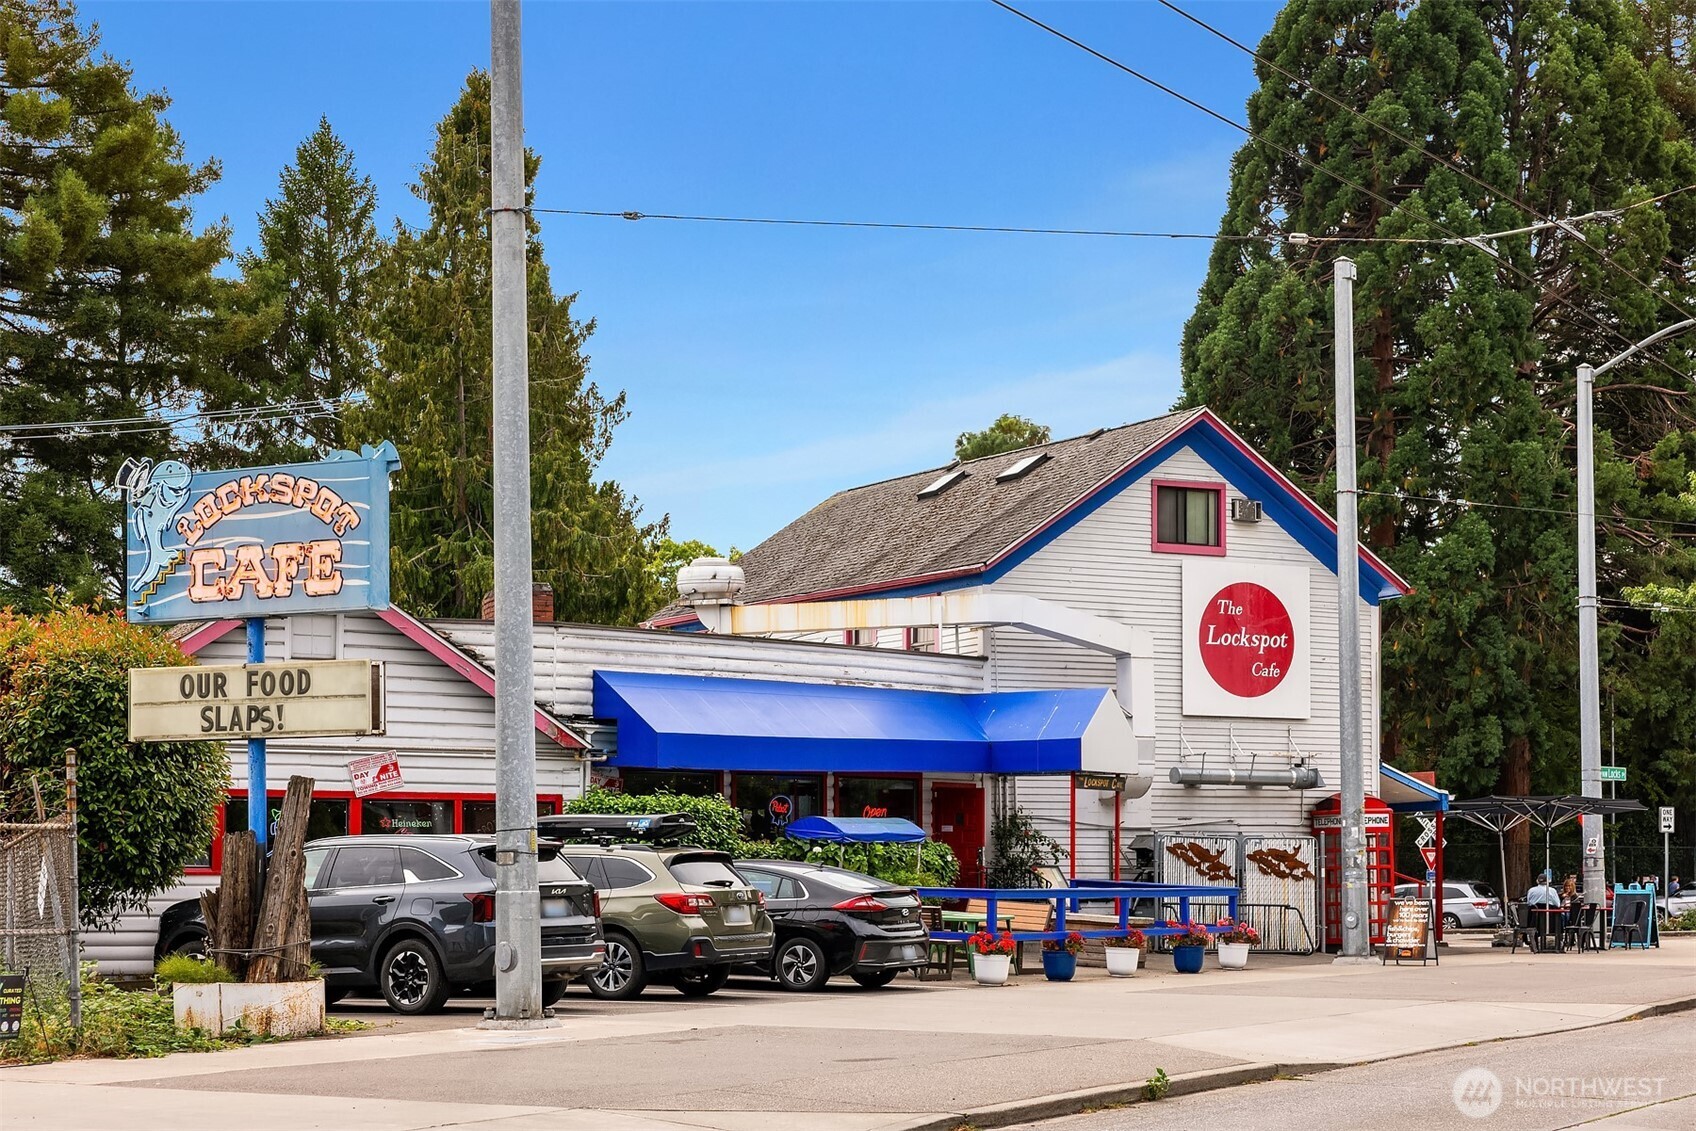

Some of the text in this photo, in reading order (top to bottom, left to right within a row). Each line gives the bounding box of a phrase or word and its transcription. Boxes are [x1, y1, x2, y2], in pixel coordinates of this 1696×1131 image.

[176, 472, 361, 546] LOCKSPOT
[188, 538, 343, 604] CAFE
[1217, 600, 1242, 615] The
[1206, 625, 1288, 654] Lockspot
[1252, 662, 1280, 677] Cafe
[179, 668, 311, 699] OUR FOOD
[200, 704, 284, 733] SLAPS!
[354, 771, 369, 780] DAY
[380, 771, 399, 781] NITE
[1608, 768, 1621, 778] Locks
[863, 805, 888, 818] Open
[391, 819, 433, 828] Heineken
[1315, 817, 1341, 826] TELEPHON
[1364, 816, 1388, 825] EPHONE
